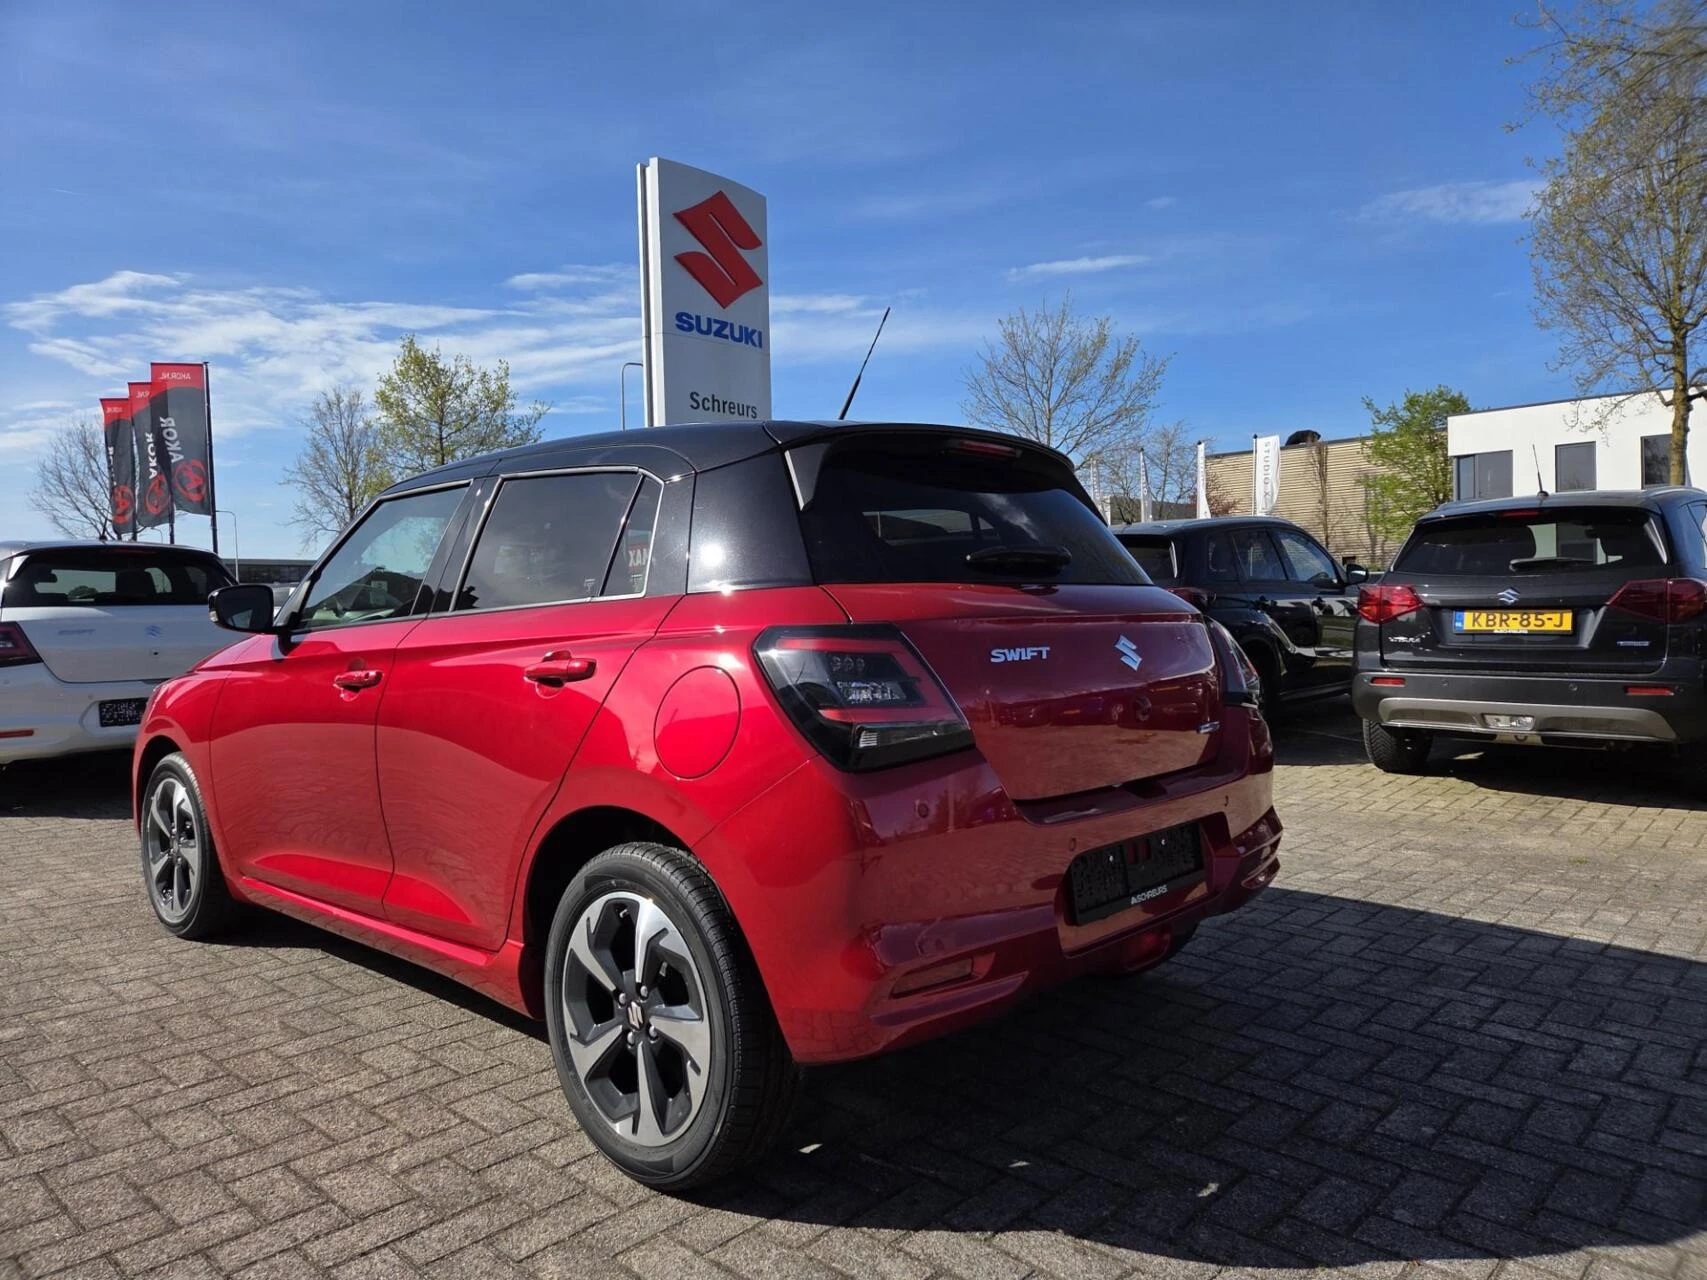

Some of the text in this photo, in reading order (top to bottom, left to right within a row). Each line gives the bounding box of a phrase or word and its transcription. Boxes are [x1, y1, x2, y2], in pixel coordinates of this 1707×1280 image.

[675, 311, 763, 349] SUZUKI
[689, 391, 758, 419] Schreurs
[1472, 611, 1564, 628] KBR-85-J
[990, 646, 1050, 663] SWIFT
